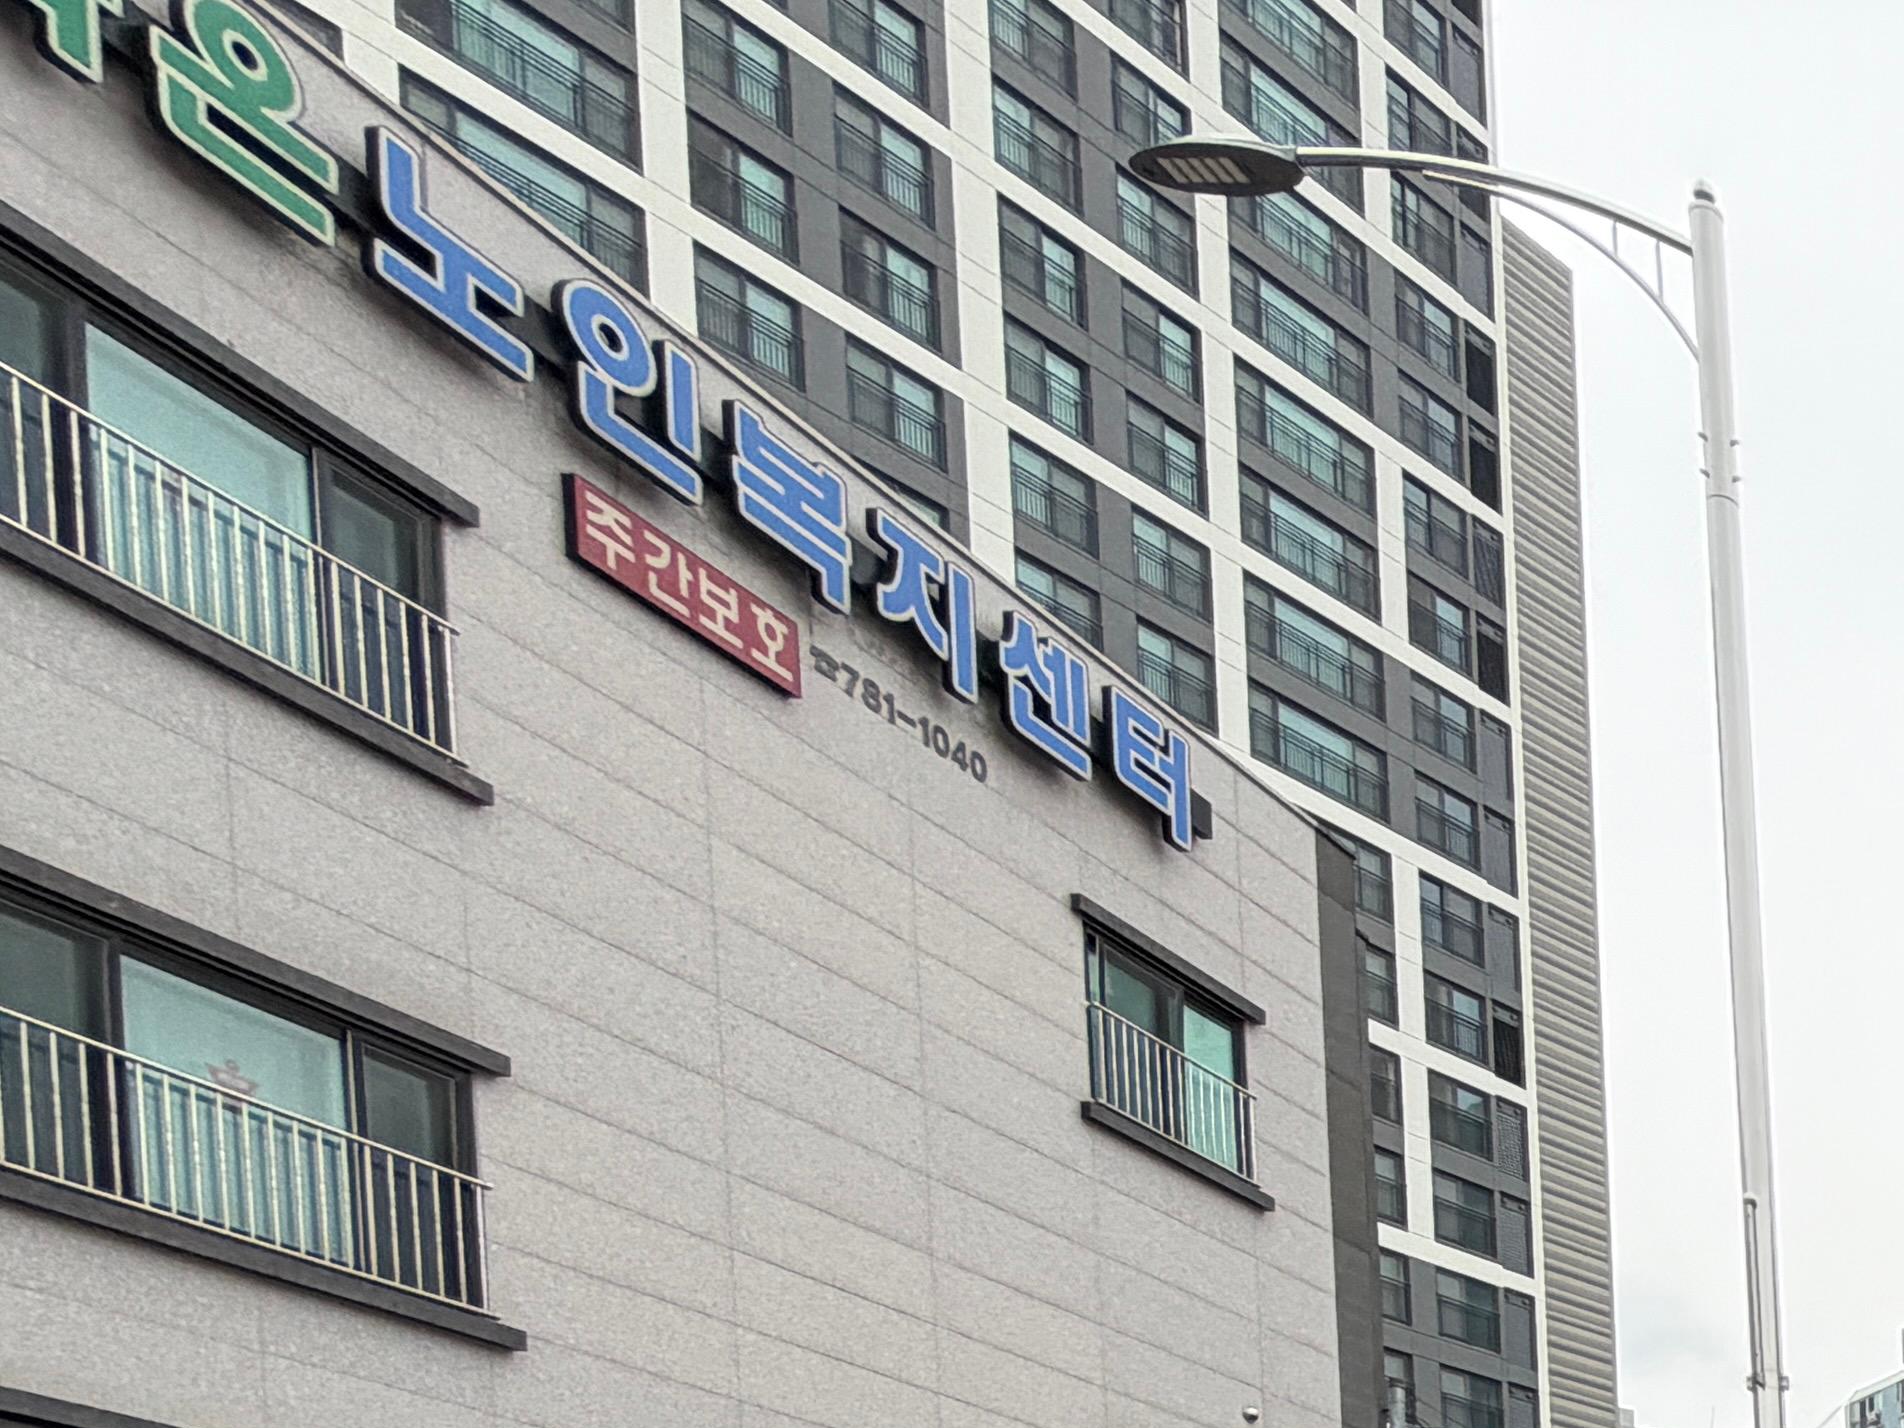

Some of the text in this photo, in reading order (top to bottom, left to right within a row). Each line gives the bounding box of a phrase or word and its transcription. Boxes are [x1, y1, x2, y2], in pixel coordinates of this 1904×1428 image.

[368, 124, 1193, 851] 노인복지센터
[585, 489, 792, 682] 주간보호
[840, 663, 988, 784] 781-1040
